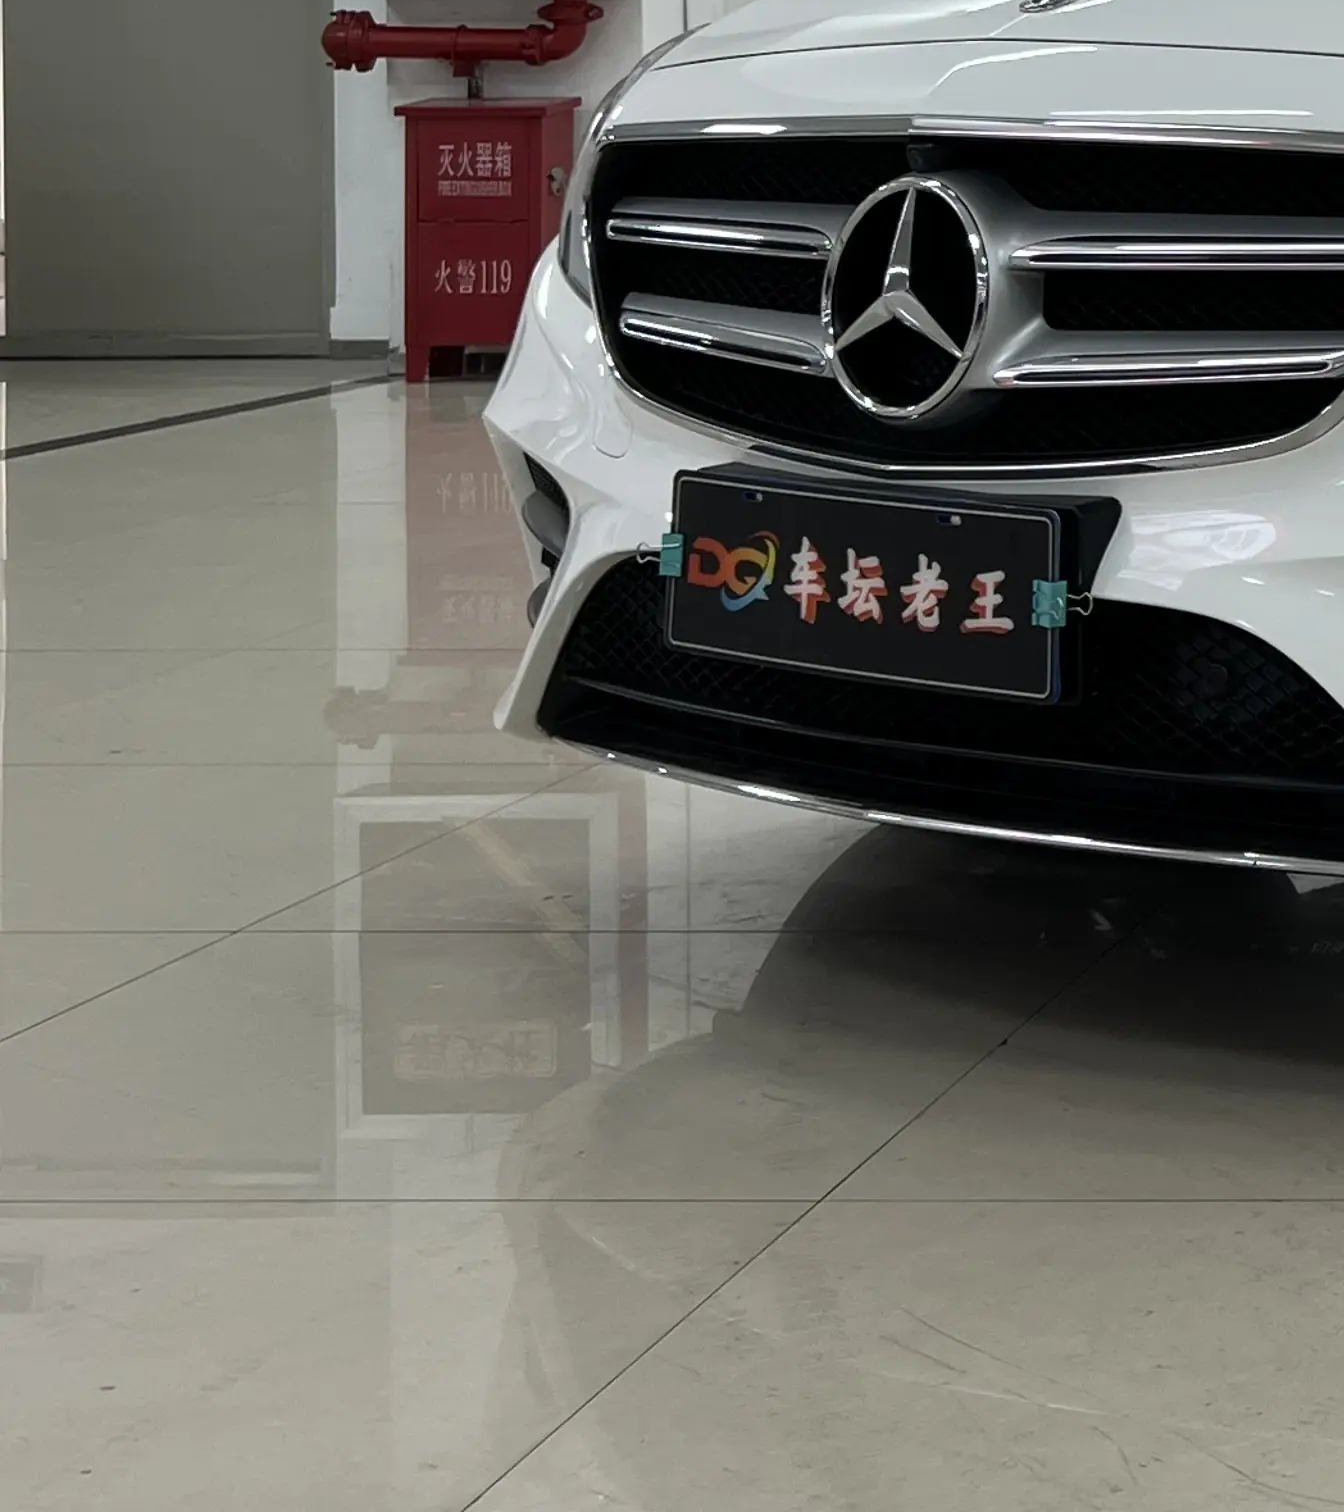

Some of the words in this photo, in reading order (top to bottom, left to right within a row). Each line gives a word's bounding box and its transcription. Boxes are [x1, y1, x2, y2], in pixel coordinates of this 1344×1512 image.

[437, 141, 513, 178] 灭火器箱
[434, 258, 513, 295] 火警119
[783, 534, 1016, 634] 车坛老王
